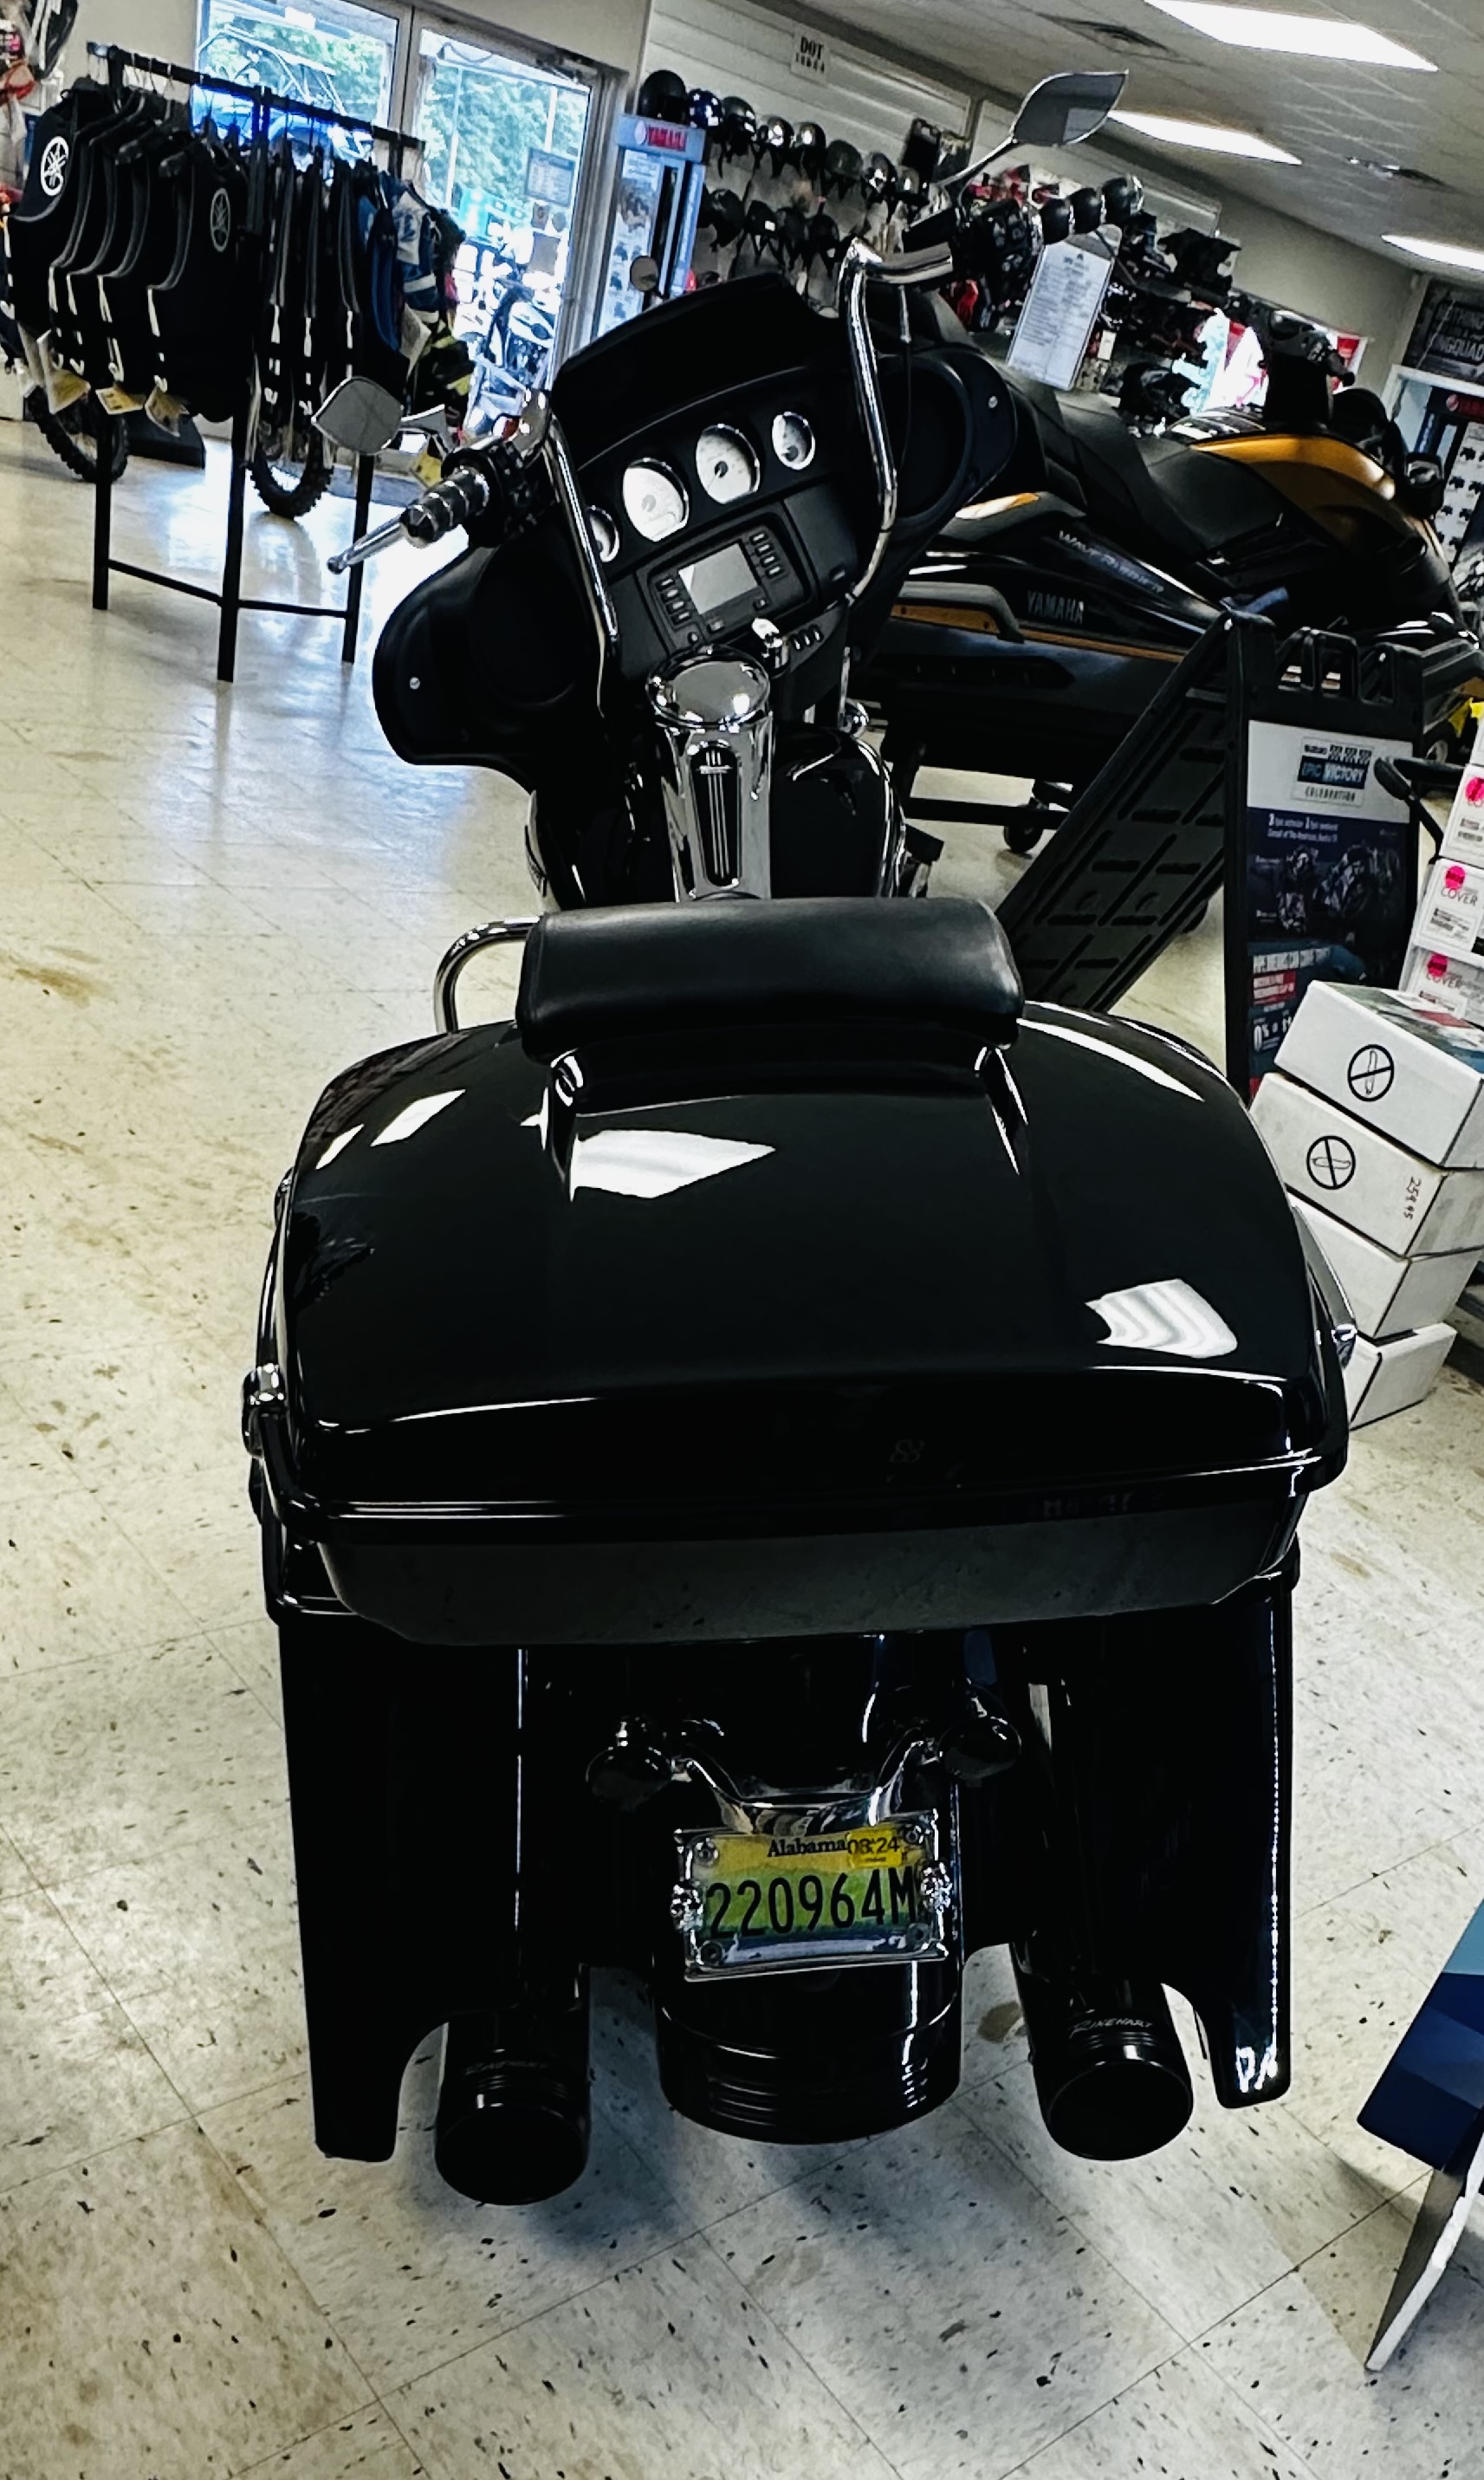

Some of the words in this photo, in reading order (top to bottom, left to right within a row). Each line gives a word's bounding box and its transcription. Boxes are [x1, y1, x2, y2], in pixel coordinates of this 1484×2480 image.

[800, 36, 824, 61] DOT
[1027, 590, 1084, 625] YAMAHA
[1323, 763, 1365, 783] VICTORY
[767, 1837, 847, 1858] Alabama
[706, 1866, 916, 1939] 220964M
